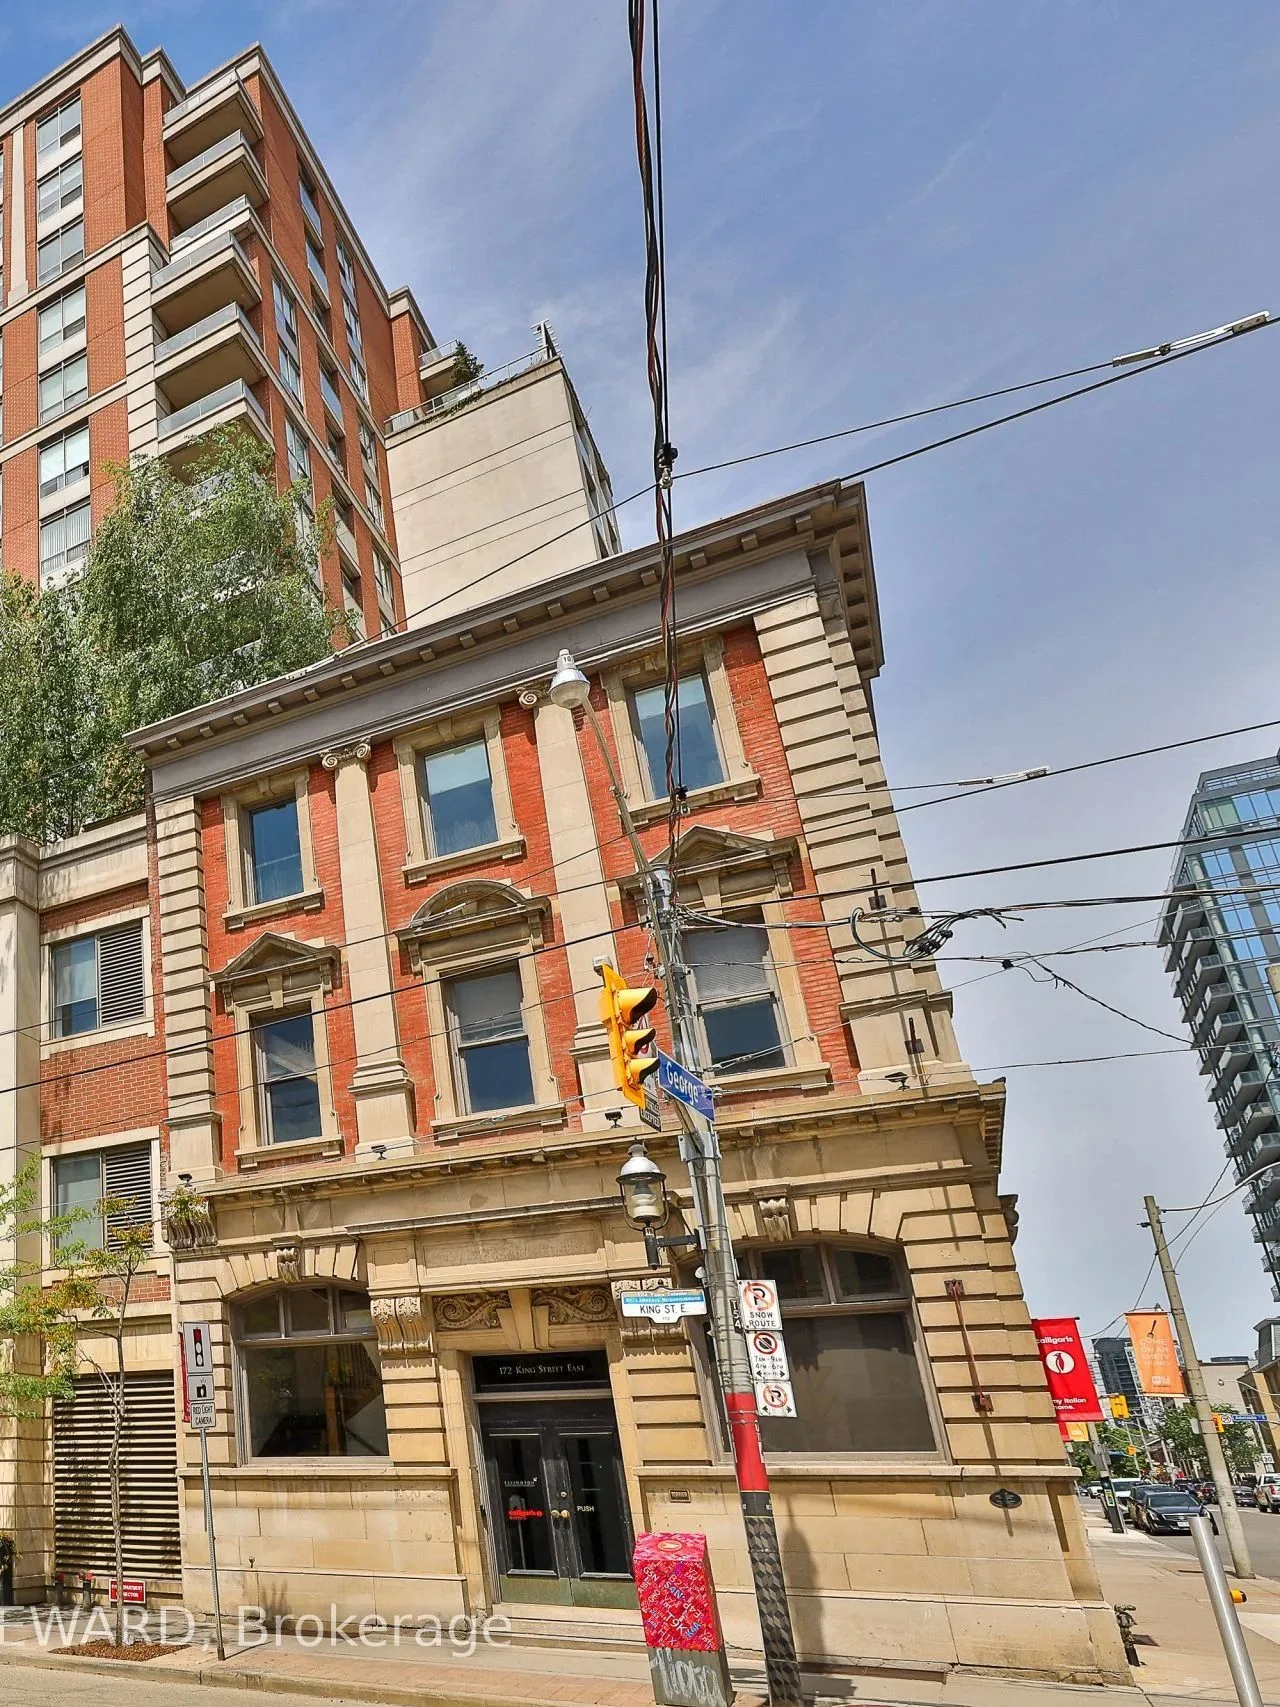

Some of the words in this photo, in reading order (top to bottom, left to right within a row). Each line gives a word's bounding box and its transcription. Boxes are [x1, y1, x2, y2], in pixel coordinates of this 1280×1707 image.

[666, 1061, 699, 1105] George
[639, 1305, 661, 1314] KING
[664, 1304, 678, 1314] ST.
[749, 1311, 773, 1319] SNOW
[499, 1366, 513, 1375] 172
[192, 1406, 201, 1415] RED
[202, 1405, 213, 1414] LIGHT
[195, 1416, 213, 1426] CAMERA
[666, 1610, 688, 1635] T9K
